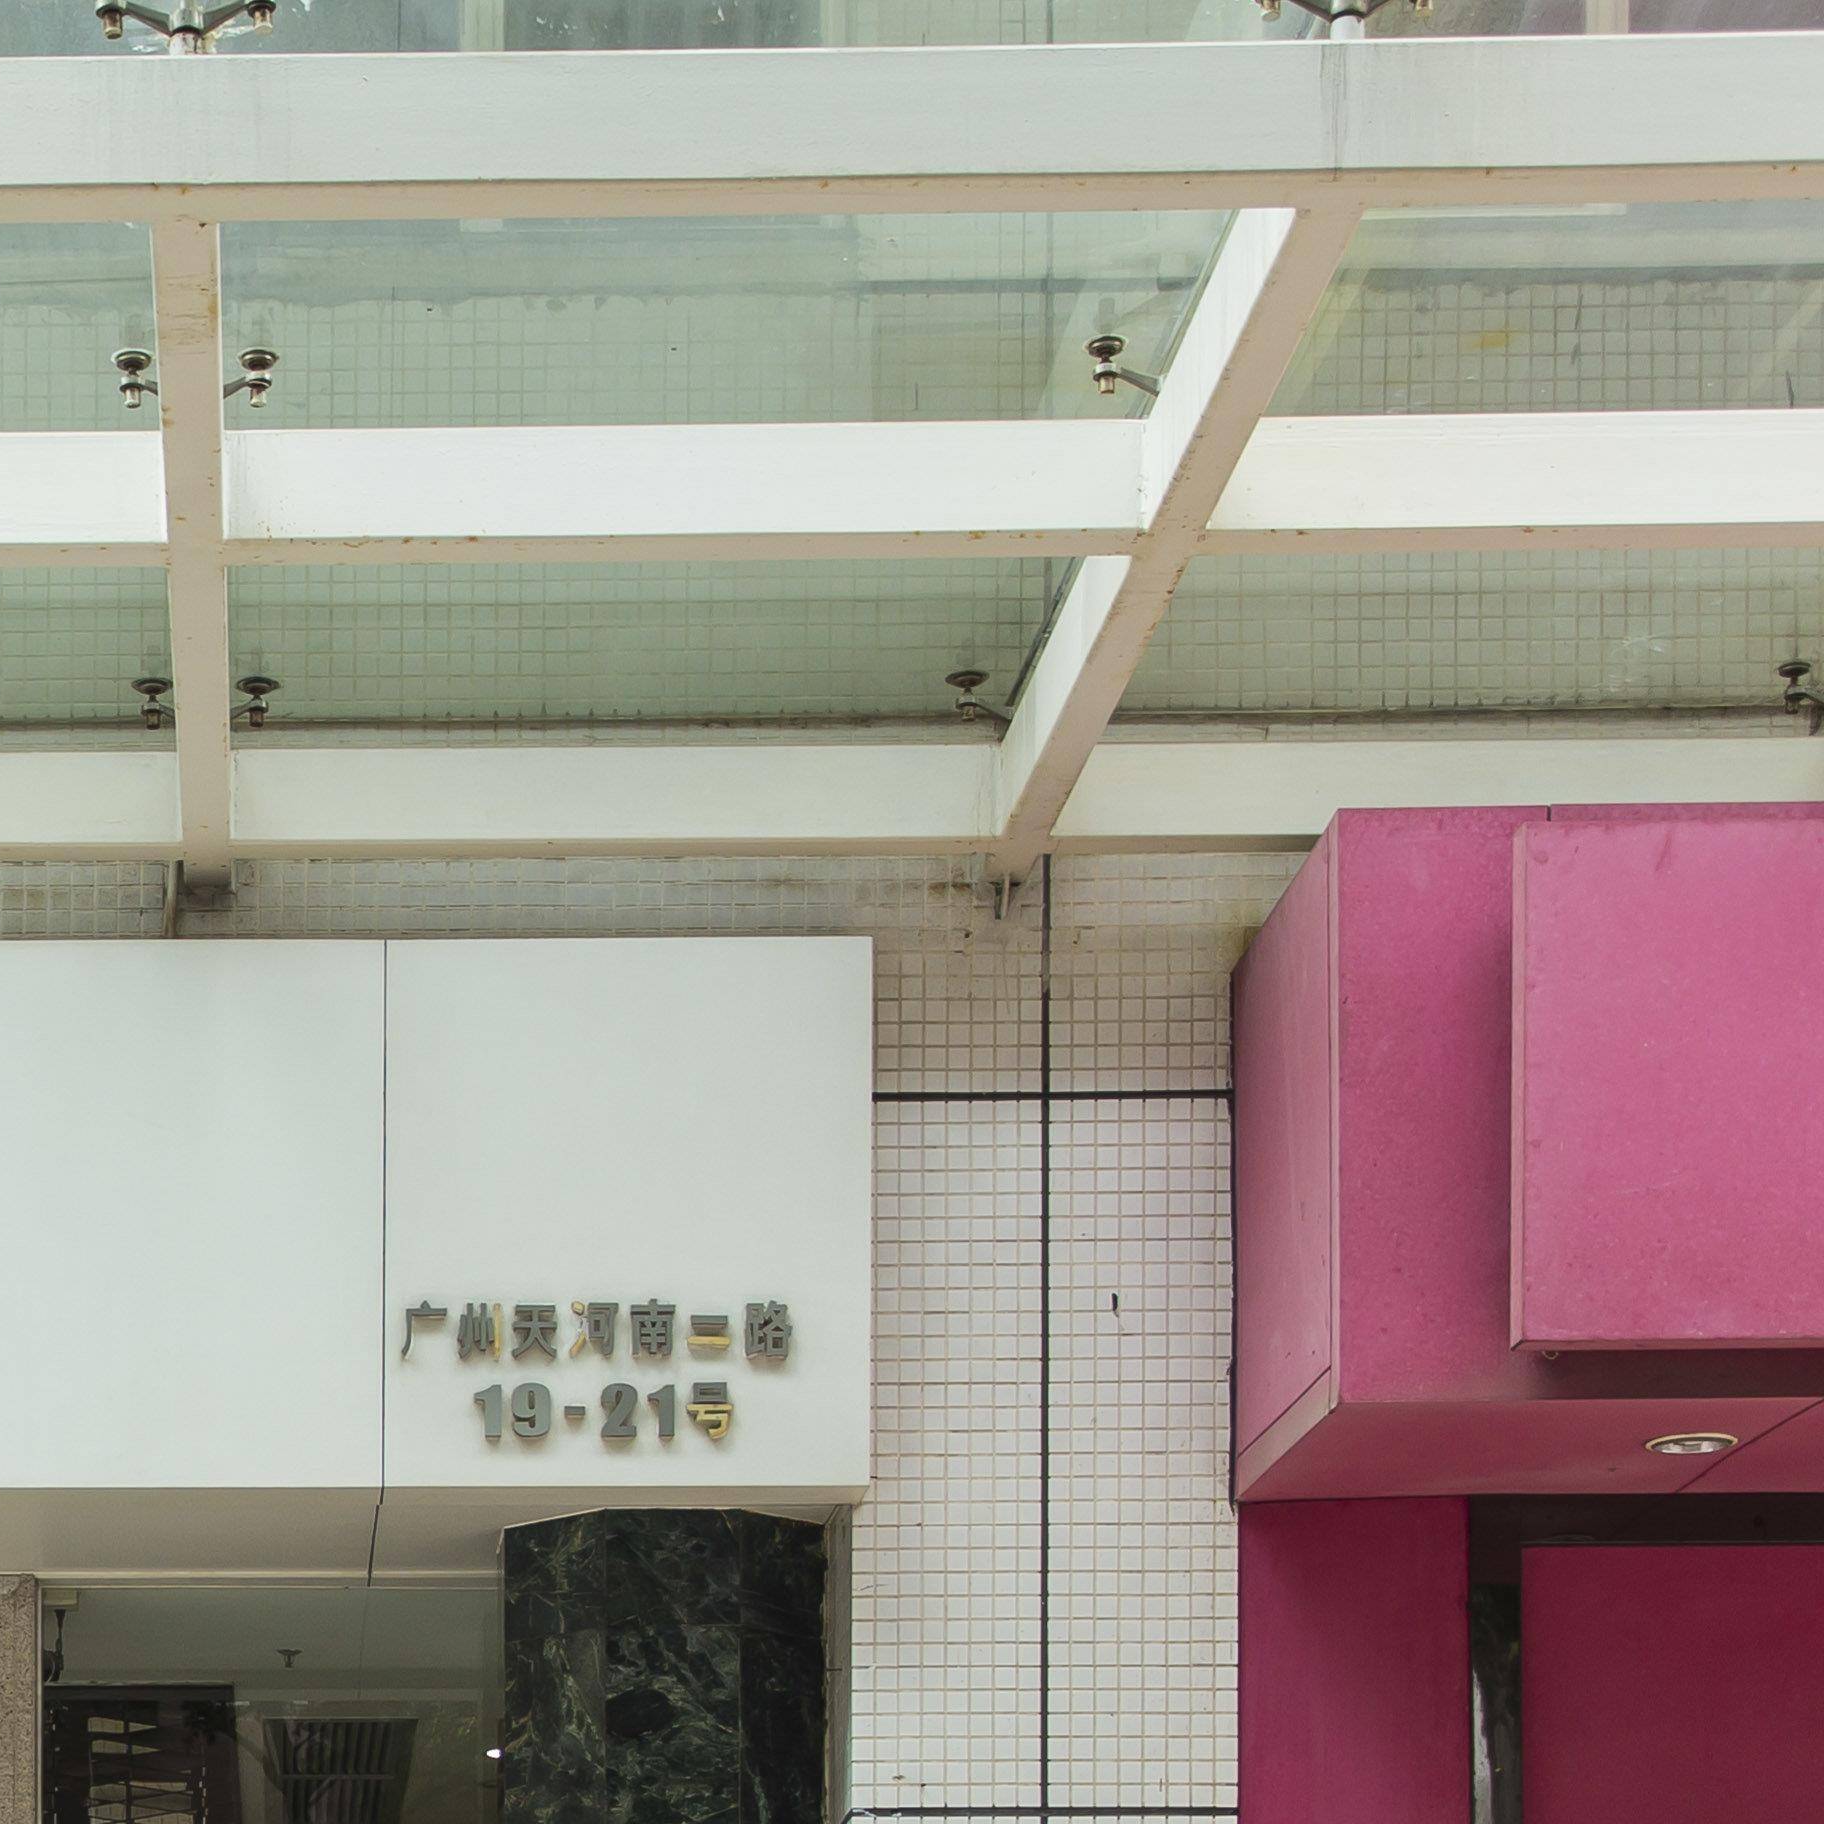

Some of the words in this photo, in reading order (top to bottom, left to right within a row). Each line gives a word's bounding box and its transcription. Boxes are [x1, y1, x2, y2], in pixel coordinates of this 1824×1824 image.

[402, 1299, 792, 1362] 广州天河南二路
[474, 1382, 733, 1440] 19-21号
